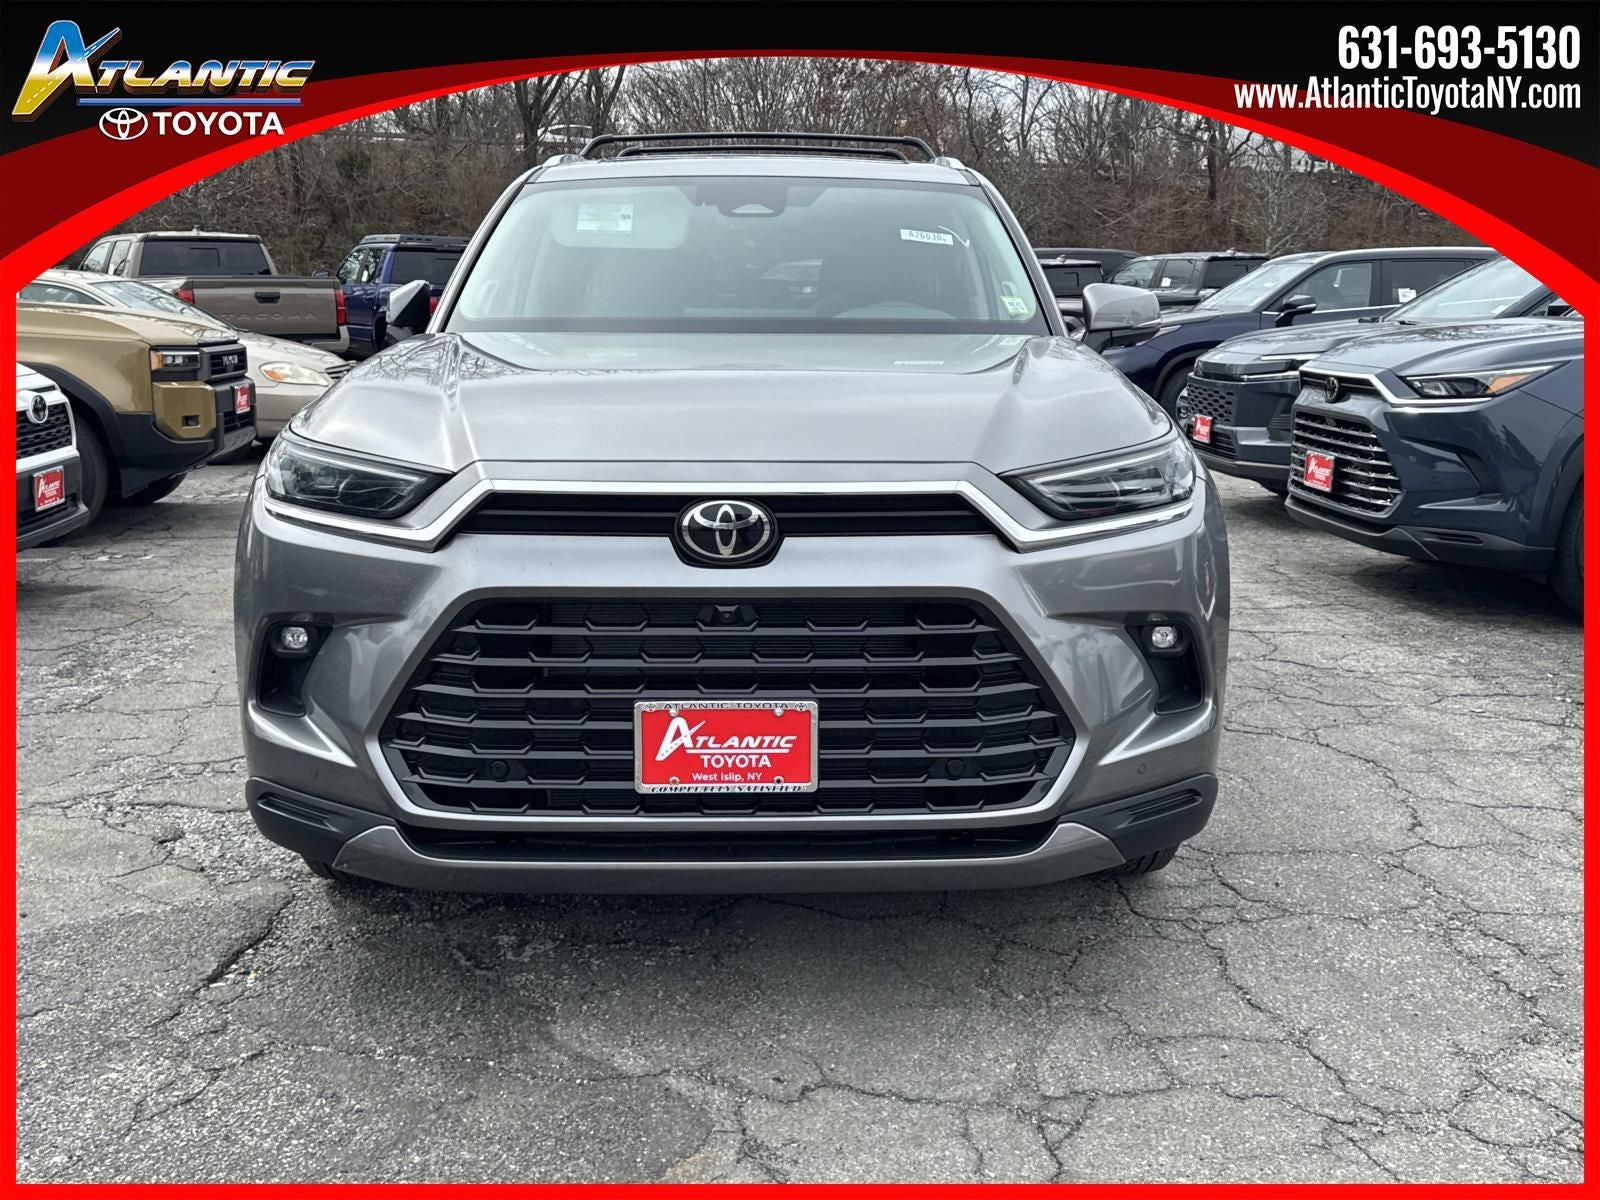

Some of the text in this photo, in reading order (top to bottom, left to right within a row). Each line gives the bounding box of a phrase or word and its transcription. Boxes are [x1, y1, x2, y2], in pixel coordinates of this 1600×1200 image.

[663, 702, 790, 710] ATLANTIC TOYOTA
[655, 716, 798, 762] ATLANTIC
[700, 754, 772, 769] TOYOTA
[692, 771, 763, 784] West Islip, NY
